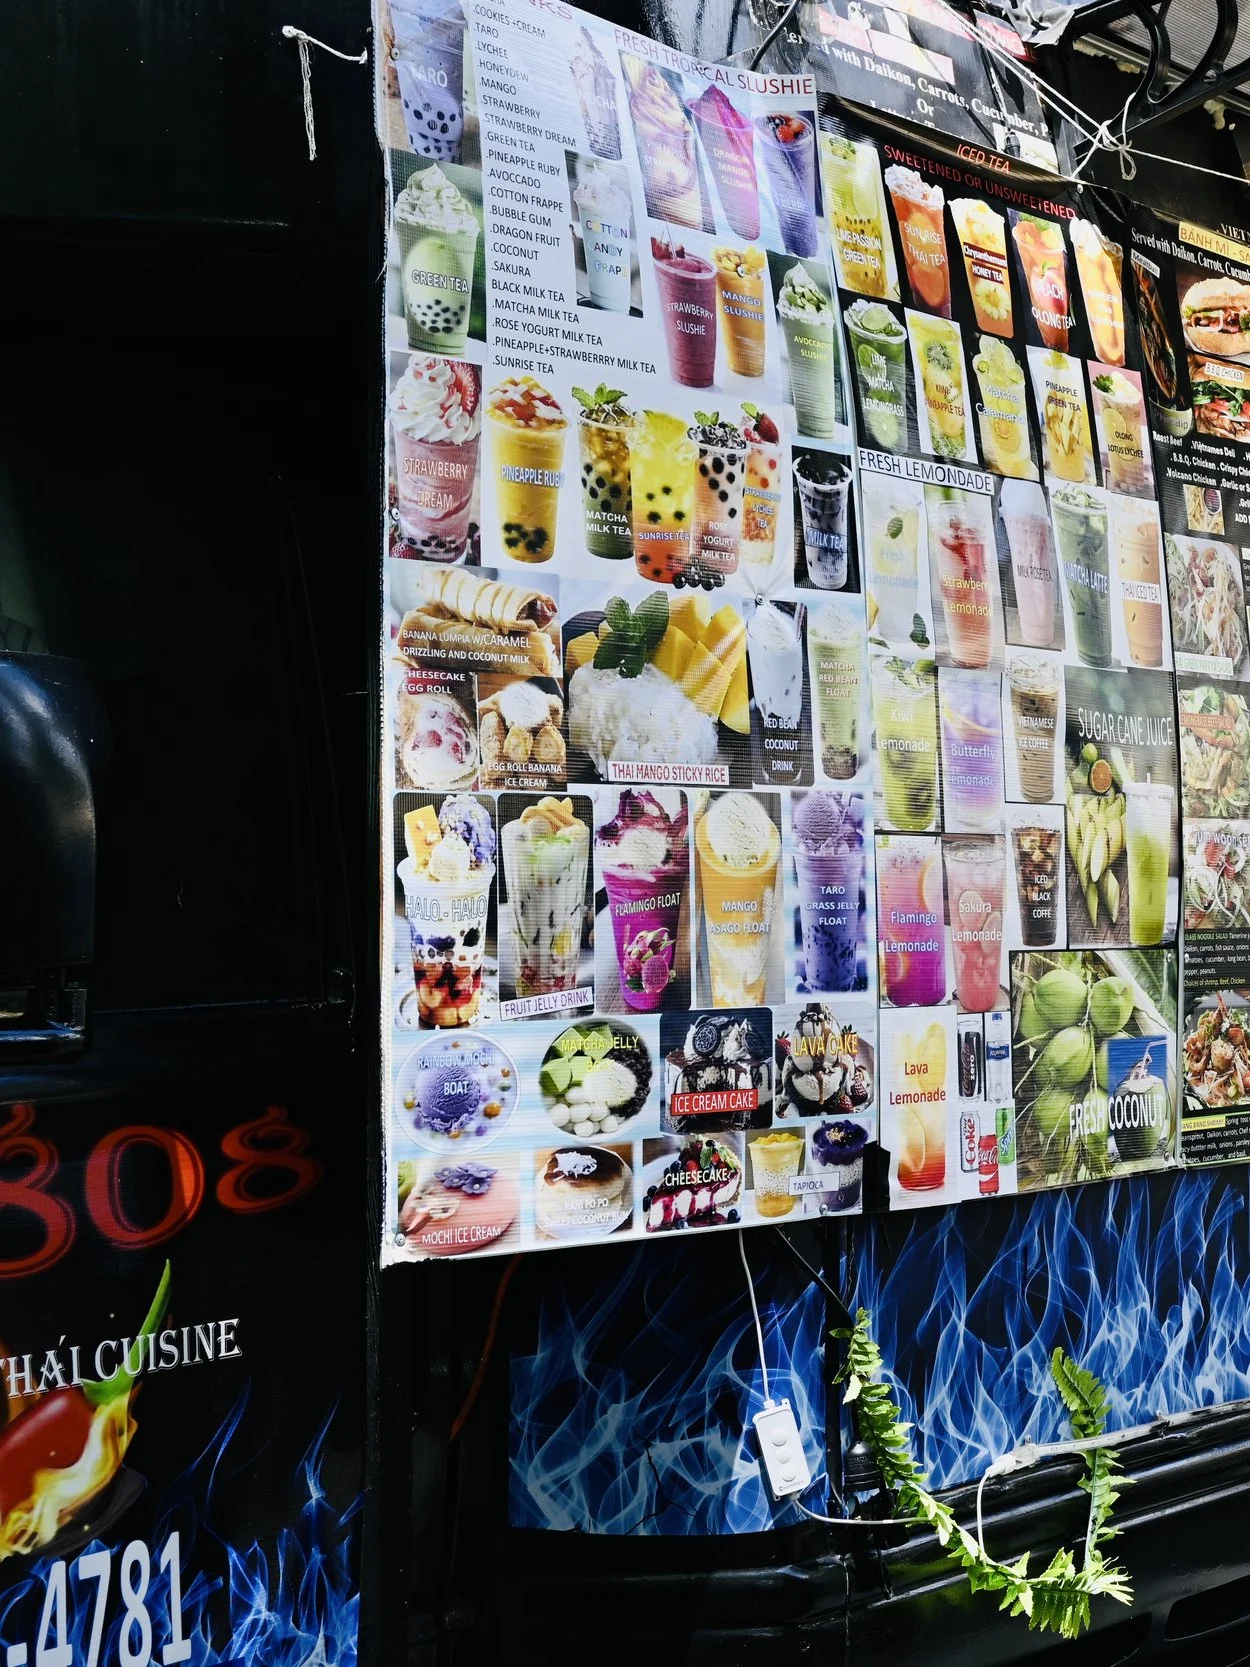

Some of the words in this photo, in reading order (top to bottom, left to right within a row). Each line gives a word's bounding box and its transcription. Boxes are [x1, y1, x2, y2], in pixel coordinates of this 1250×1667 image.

[614, 28, 659, 61] FRESH
[738, 75, 813, 94] SLUSHIE
[833, 44, 861, 68] with
[863, 56, 916, 90] Daikon,
[918, 77, 969, 111] Carrots,
[957, 143, 984, 165] ICED
[989, 155, 1010, 175] TEA
[884, 145, 961, 182] SWEETENED
[965, 174, 981, 189] OR
[985, 178, 1076, 219] UNSWEETENED
[529, 213, 552, 227] GUM
[1180, 226, 1212, 249] BÁNH
[908, 242, 928, 262] THAI
[930, 249, 945, 266] TEA
[412, 269, 447, 288] GREEN
[450, 277, 468, 293] TEA
[972, 263, 988, 279] HONEY
[990, 268, 1003, 283] TEA
[492, 279, 521, 295] BLACK
[524, 285, 545, 299] MILK
[548, 290, 565, 302] TEA
[722, 290, 760, 307] MANGO
[666, 302, 713, 320] STRAWBERRY
[724, 305, 764, 321] SLUSHIE
[677, 320, 706, 336] SLUSHIE
[871, 354, 886, 366] LIME
[1046, 381, 1077, 397] PINEAPPLE
[864, 398, 904, 417] LEMONGRASS
[1047, 396, 1066, 409] GREEN
[1068, 401, 1081, 412] TEA
[1115, 431, 1133, 442] OLONG
[403, 457, 468, 480] STRAWBERRY
[860, 449, 901, 474] FRESH
[905, 458, 992, 492] LEMONDADE
[418, 490, 453, 510] DREAM
[586, 510, 628, 523] MATCHA
[1235, 513, 1247, 523] ADD
[586, 524, 609, 534] MILK
[612, 526, 631, 536] TEA
[639, 531, 672, 540] SUNRISE
[674, 532, 689, 541] TEA
[703, 534, 733, 546] YOGURT
[809, 530, 826, 548] MILK
[828, 534, 844, 549] TEA
[702, 550, 717, 559] MILK
[719, 551, 735, 561] TEA
[1064, 562, 1088, 586] MATCHA
[1090, 574, 1108, 594] LATTE
[403, 631, 437, 641] BANANA
[439, 633, 470, 643] LUMPIA
[403, 648, 446, 659] DRIZZLING
[448, 651, 466, 660] AND
[468, 653, 508, 662] COCONUT
[510, 656, 529, 664] MILK
[1018, 716, 1054, 729] VIETNAMESE
[1078, 708, 1114, 742] SUGAR
[1118, 714, 1143, 745] CANE
[1146, 717, 1173, 746] JUICE
[764, 739, 798, 750] COCONUT
[876, 738, 930, 752] Lemonade
[1019, 739, 1028, 747] ICE
[1029, 739, 1049, 749] COFFEE
[612, 764, 634, 778] THAI
[636, 764, 670, 780] MANGO
[672, 766, 702, 781] STICKY
[705, 768, 726, 782] RICE
[772, 760, 793, 771] DRINK
[505, 778, 517, 786] ICE
[519, 778, 547, 787] CREAM
[820, 886, 845, 894] TARO
[616, 897, 655, 916] FLAMINGO
[658, 892, 680, 908] FLOAT
[722, 901, 758, 912] MANGO
[806, 901, 834, 910] GRASS
[837, 901, 859, 910] JELLY
[959, 900, 991, 912] Sakura
[819, 917, 847, 926] FLOAT
[891, 912, 937, 925] Flamingo
[952, 928, 1002, 942] Lemonade
[886, 940, 939, 952] Lemonade
[504, 1000, 532, 1016] FRUIT
[533, 996, 558, 1011] JELLY
[560, 990, 588, 1008] DRINK
[561, 1039, 604, 1051] MATCHA
[608, 1036, 638, 1049] JELLY
[792, 1036, 824, 1056] LAVA
[828, 1034, 858, 1053] CAKE
[904, 1062, 928, 1076] Lava
[444, 1082, 468, 1095] BOAT
[890, 1088, 946, 1105] Lemonade
[674, 1096, 690, 1112] ICE
[692, 1093, 726, 1111] CREAM
[730, 1092, 753, 1108] CAKE
[1070, 1102, 1105, 1138] FRESH
[1109, 1094, 1164, 1130] COCONUT
[666, 1168, 728, 1186] CHEESECAKE
[793, 1180, 824, 1191] TAPIOCA
[422, 1230, 452, 1244] MOCHI
[455, 1229, 467, 1243] ICE
[470, 1226, 501, 1242] CREAM
[95, 1318, 243, 1384] CUISINE
